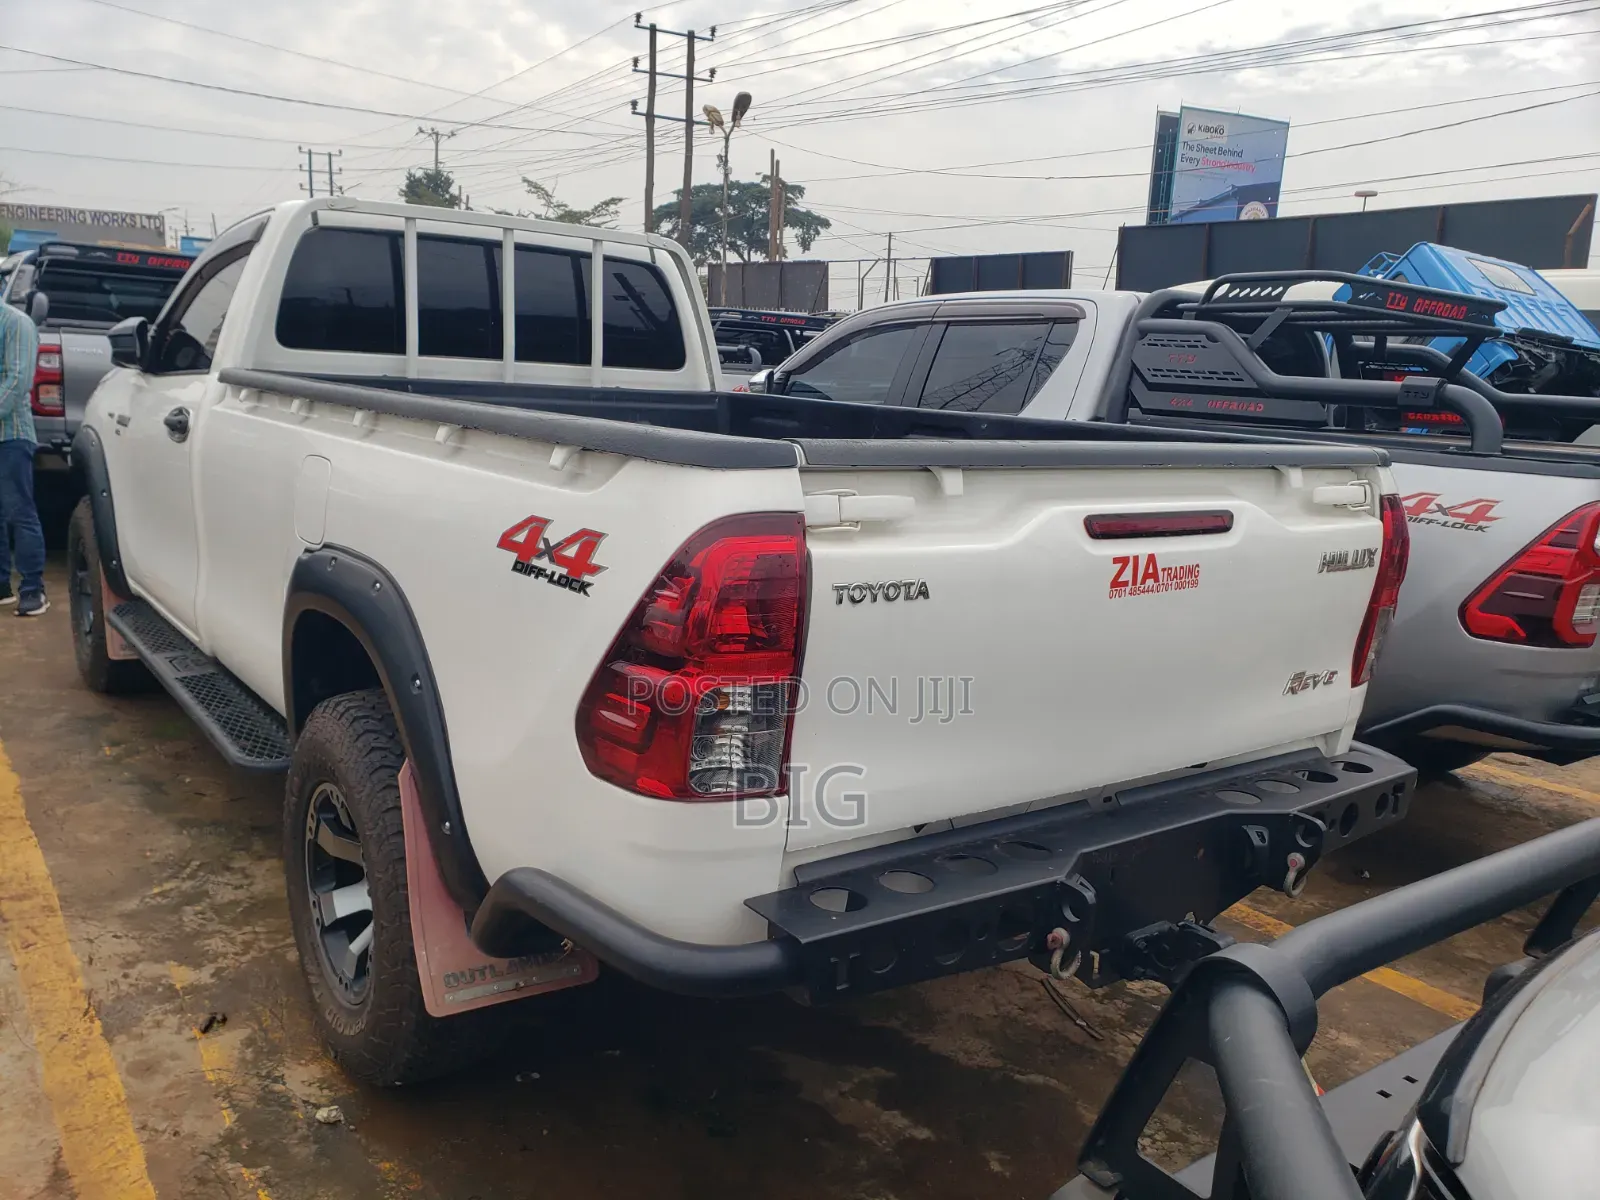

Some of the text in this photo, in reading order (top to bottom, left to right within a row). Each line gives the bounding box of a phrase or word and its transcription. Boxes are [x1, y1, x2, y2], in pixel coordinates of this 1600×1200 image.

[1180, 153, 1201, 167] Every
[1201, 156, 1226, 170] Strong
[1182, 141, 1244, 158] The Sheet Behind
[0, 203, 163, 232] ENGINEERING WORKS LTD
[1413, 297, 1468, 320] OFFROAD
[1207, 399, 1265, 412] OFFROAD
[1109, 553, 1200, 589] ZIA TRADING
[1317, 547, 1379, 574] HILUX
[511, 559, 595, 598] DIFF-LOCK
[1108, 588, 1127, 600] 0701
[1174, 579, 1199, 591] 000199
[832, 578, 930, 605] TOYOTA
